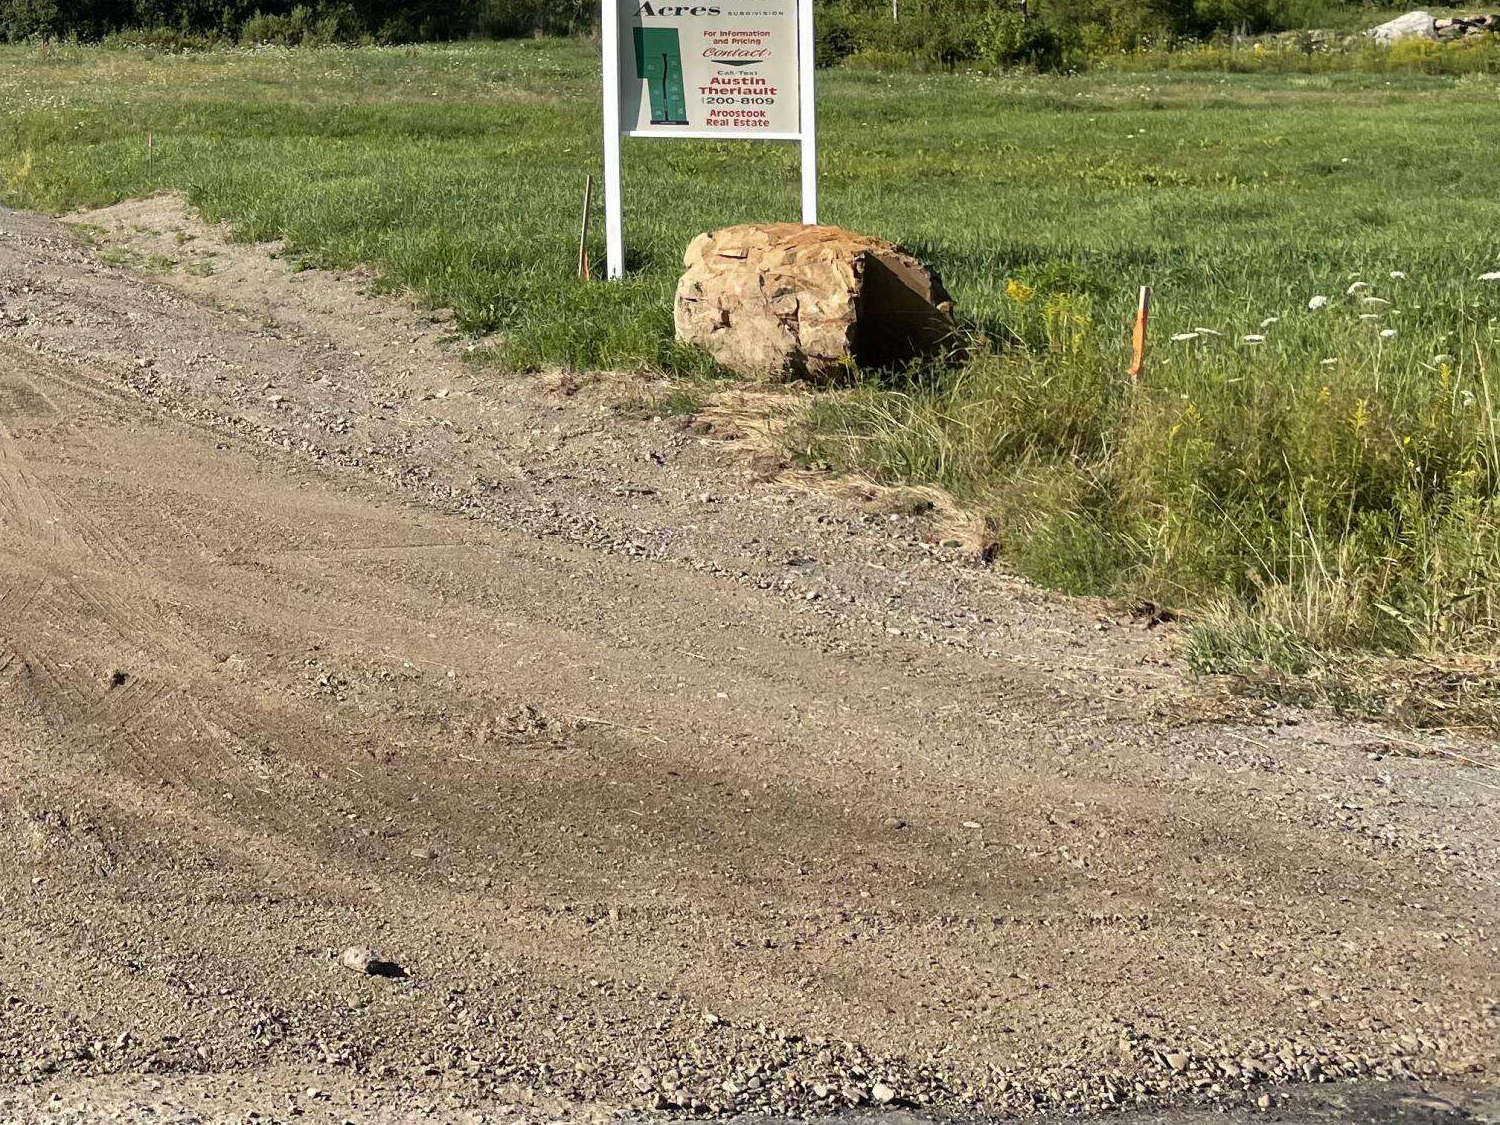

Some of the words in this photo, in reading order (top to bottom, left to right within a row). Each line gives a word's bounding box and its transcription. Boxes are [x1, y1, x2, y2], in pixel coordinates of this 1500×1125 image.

[635, 1, 721, 16] Acres
[710, 77, 766, 85] Austin
[699, 86, 777, 95] Theriault
[710, 109, 766, 117] Aroostook
[733, 119, 770, 127] Estate
